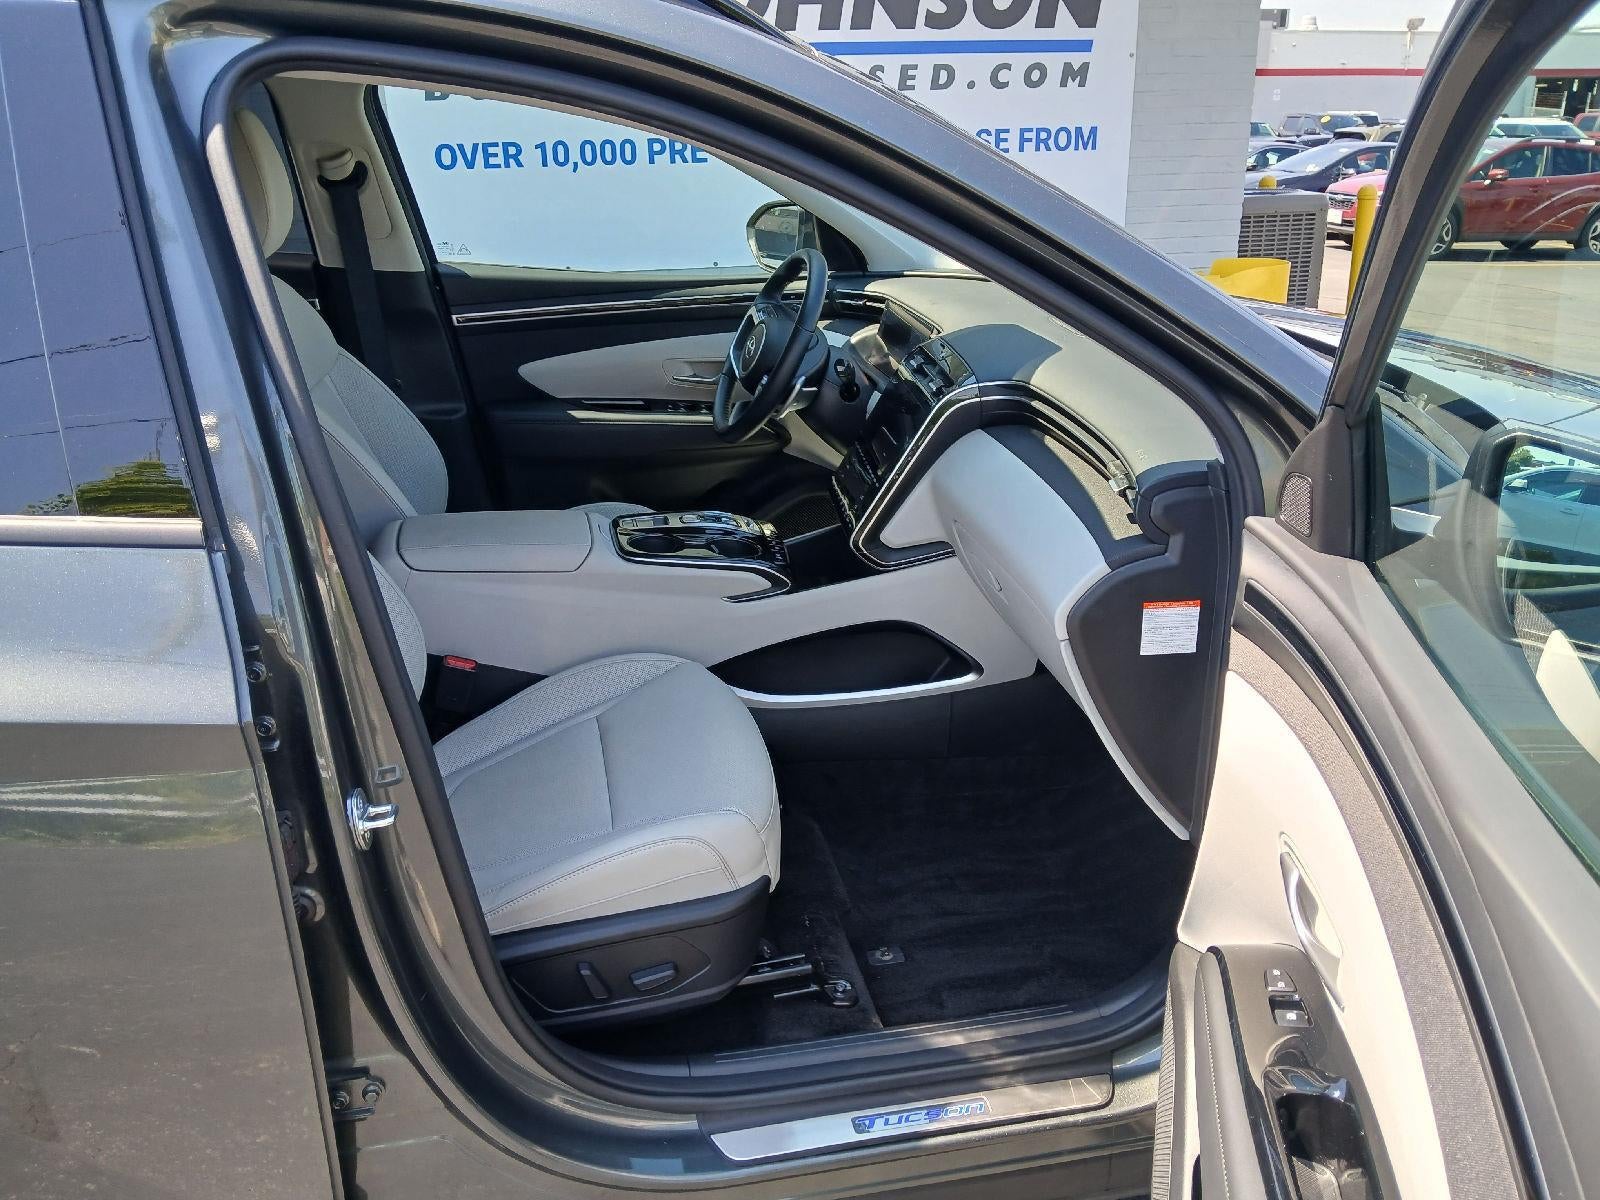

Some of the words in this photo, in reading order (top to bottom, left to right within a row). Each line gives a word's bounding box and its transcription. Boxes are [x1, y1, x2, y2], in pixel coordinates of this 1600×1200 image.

[434, 142, 524, 171] OVER
[534, 138, 637, 173] 10,000
[1018, 126, 1098, 152] FROM
